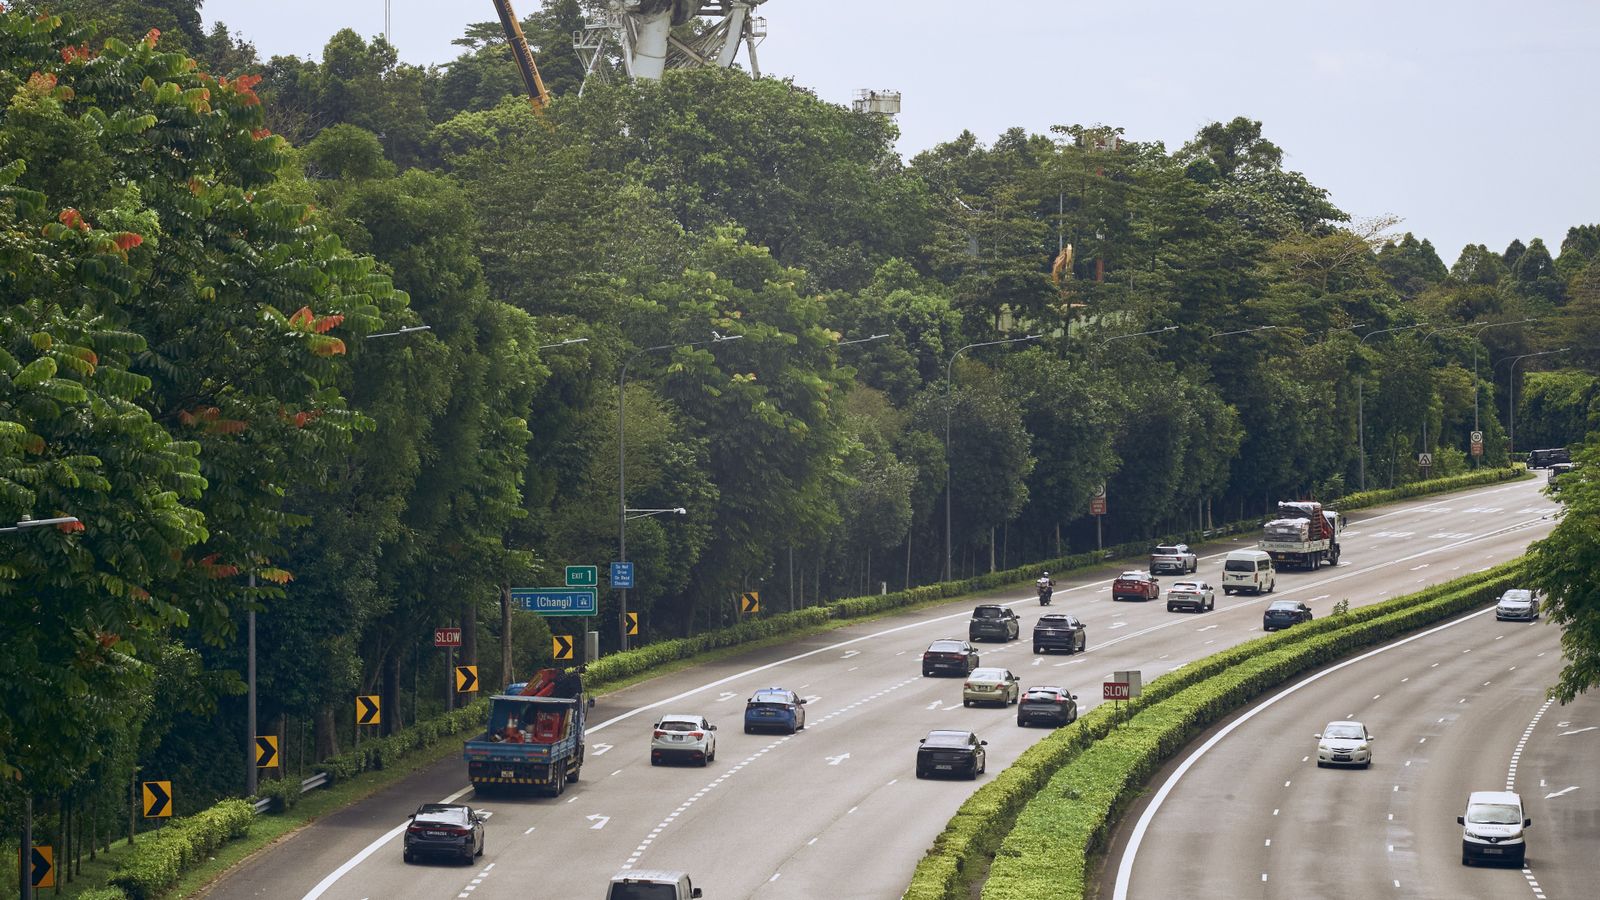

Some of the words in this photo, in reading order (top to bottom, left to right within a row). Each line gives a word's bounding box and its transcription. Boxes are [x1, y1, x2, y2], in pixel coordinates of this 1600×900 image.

[588, 570, 592, 582] 1
[536, 596, 572, 609] (Changi)
[436, 632, 460, 643] SLOW
[1104, 685, 1128, 697] SLOW
